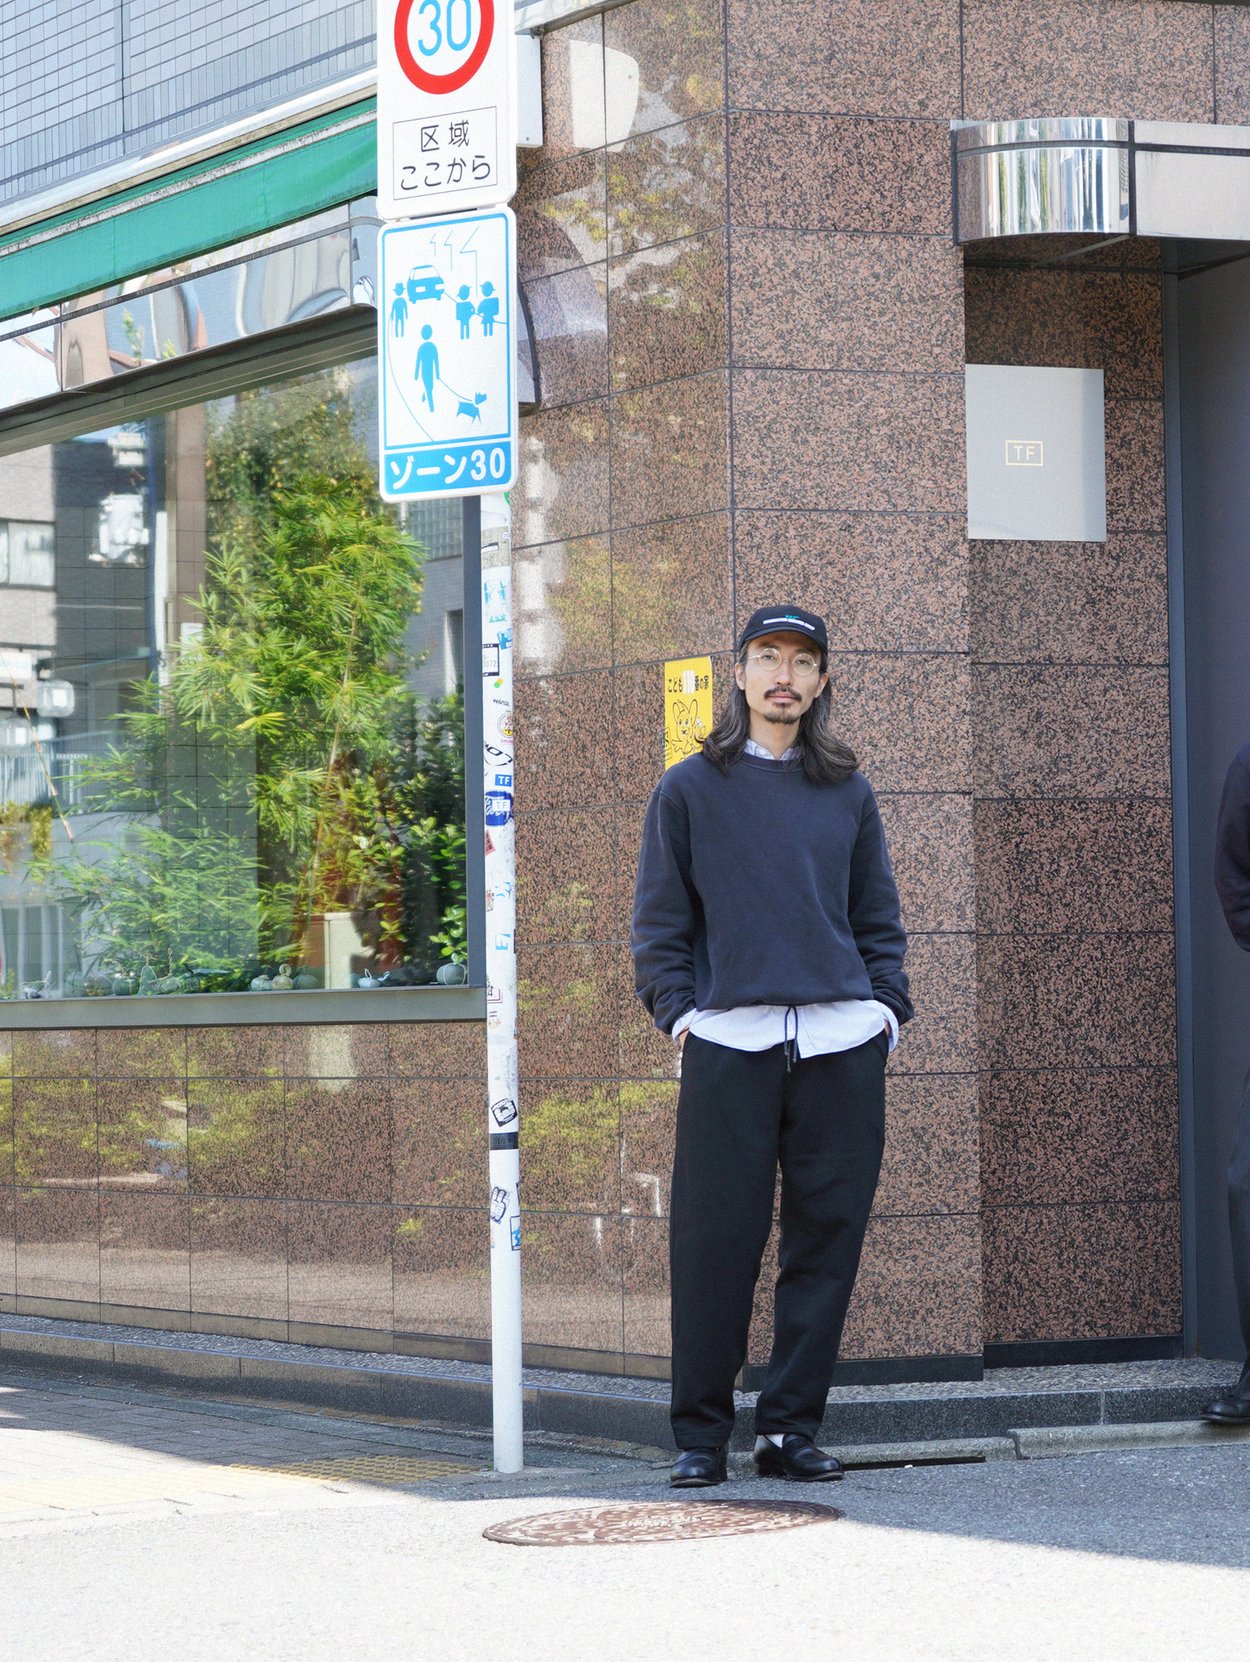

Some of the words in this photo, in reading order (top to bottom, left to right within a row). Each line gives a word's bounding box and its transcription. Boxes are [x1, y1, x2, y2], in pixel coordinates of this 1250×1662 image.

[418, 0, 471, 56] 30
[421, 120, 469, 152] 区域
[401, 155, 491, 190] ここから
[390, 447, 506, 490] ゾーン30
[1013, 445, 1035, 460] TF
[498, 775, 511, 785] TF
[496, 801, 508, 810] TF
